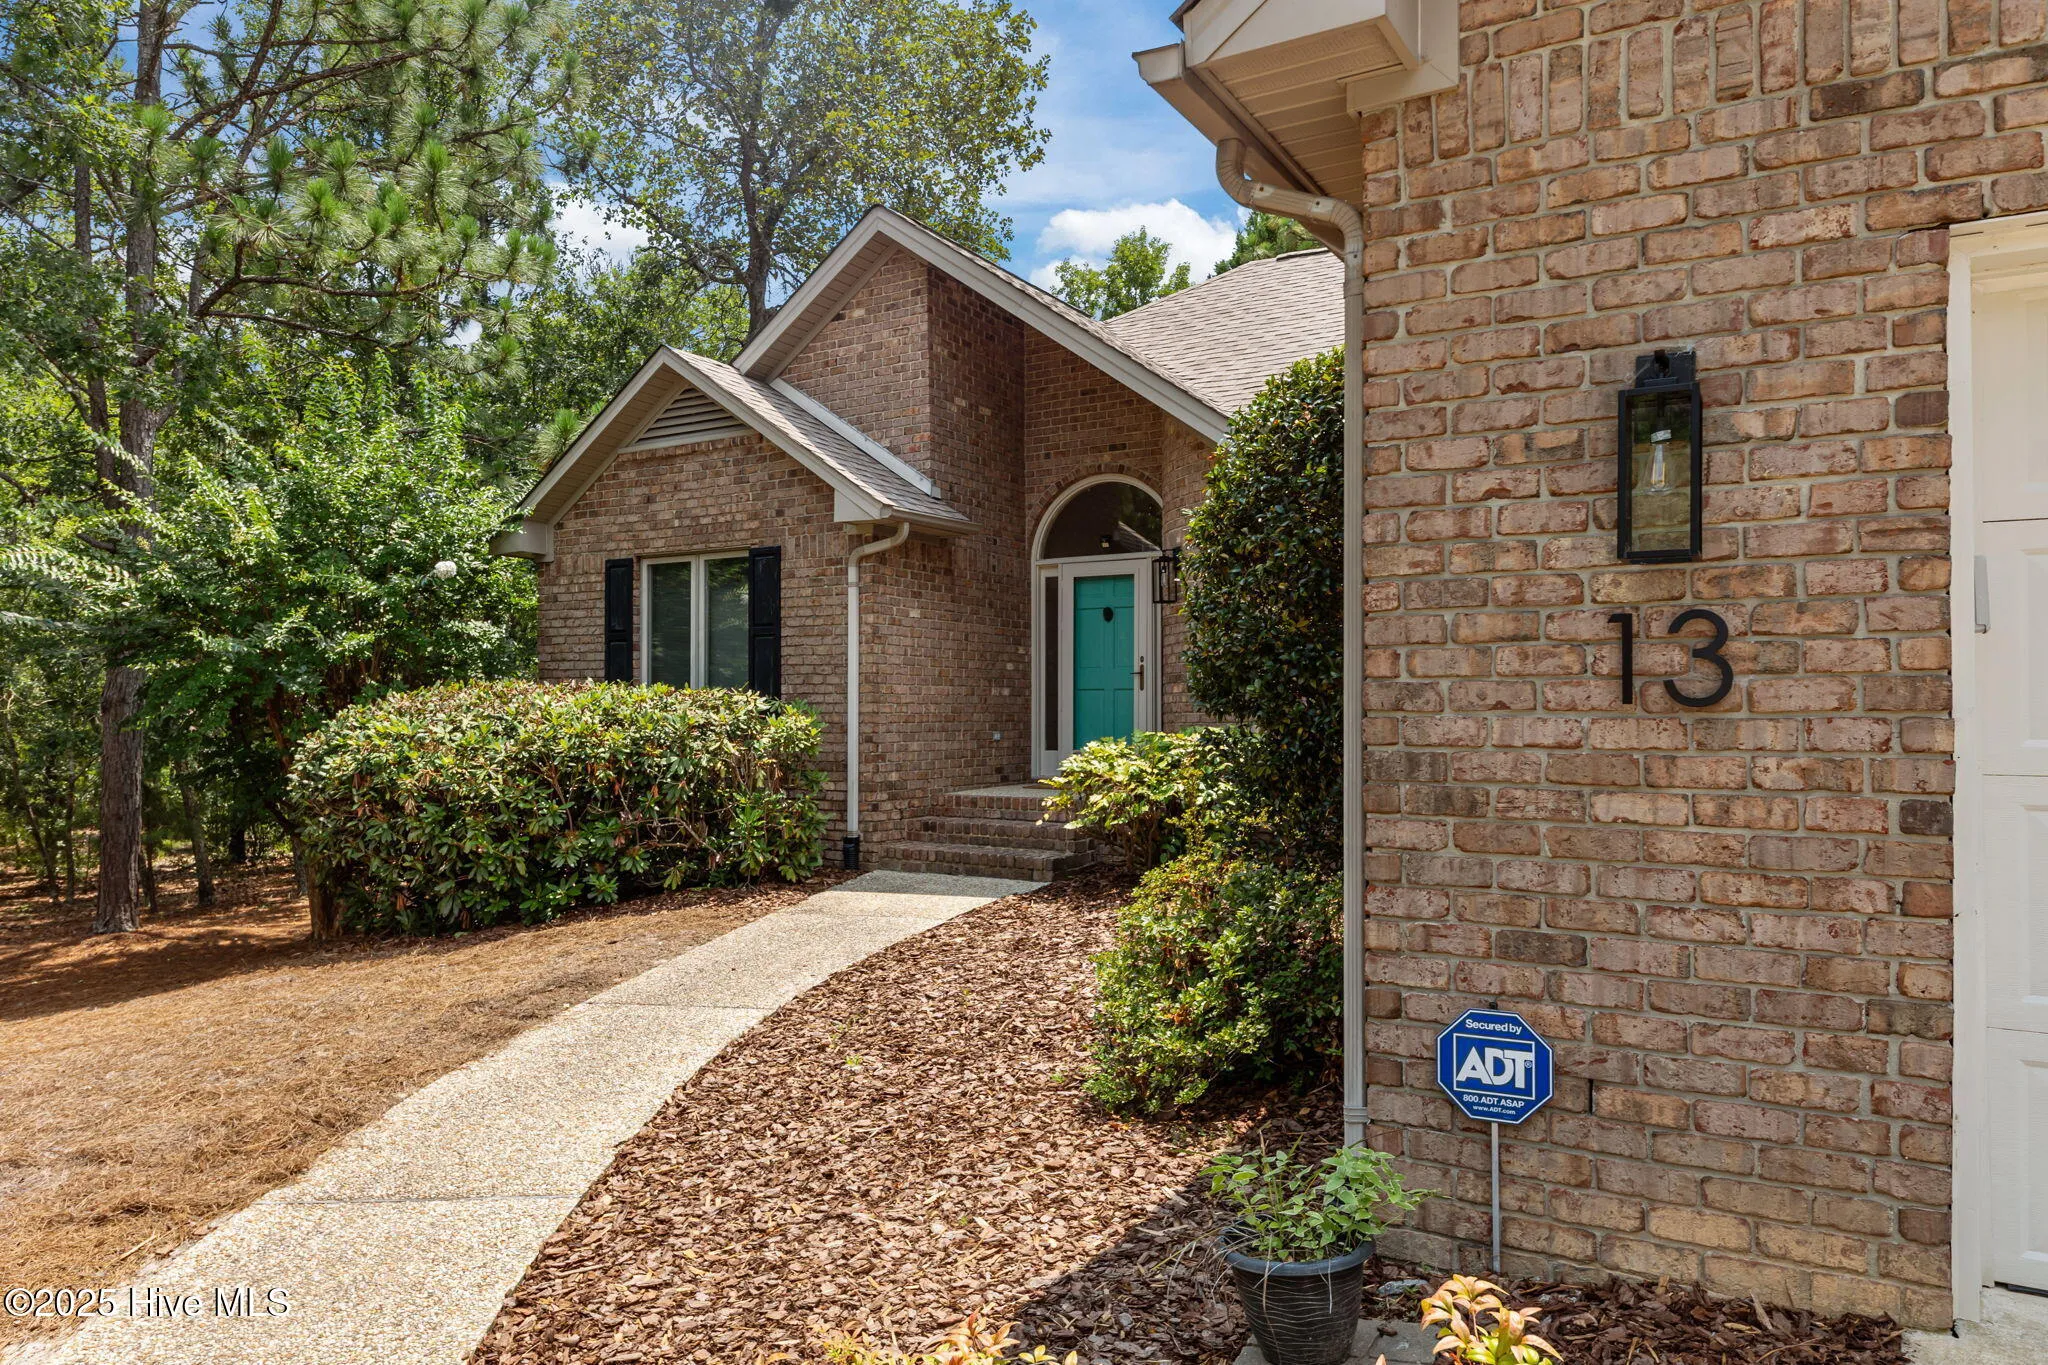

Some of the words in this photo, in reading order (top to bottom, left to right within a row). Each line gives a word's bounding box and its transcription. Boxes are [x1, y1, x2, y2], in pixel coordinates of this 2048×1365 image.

[1607, 609, 1734, 708] 13
[1465, 1019, 1508, 1033] Secured
[1509, 1023, 1522, 1035] by
[1455, 1046, 1533, 1089] ADT
[1472, 1105, 1516, 1115] www.ADT.com
